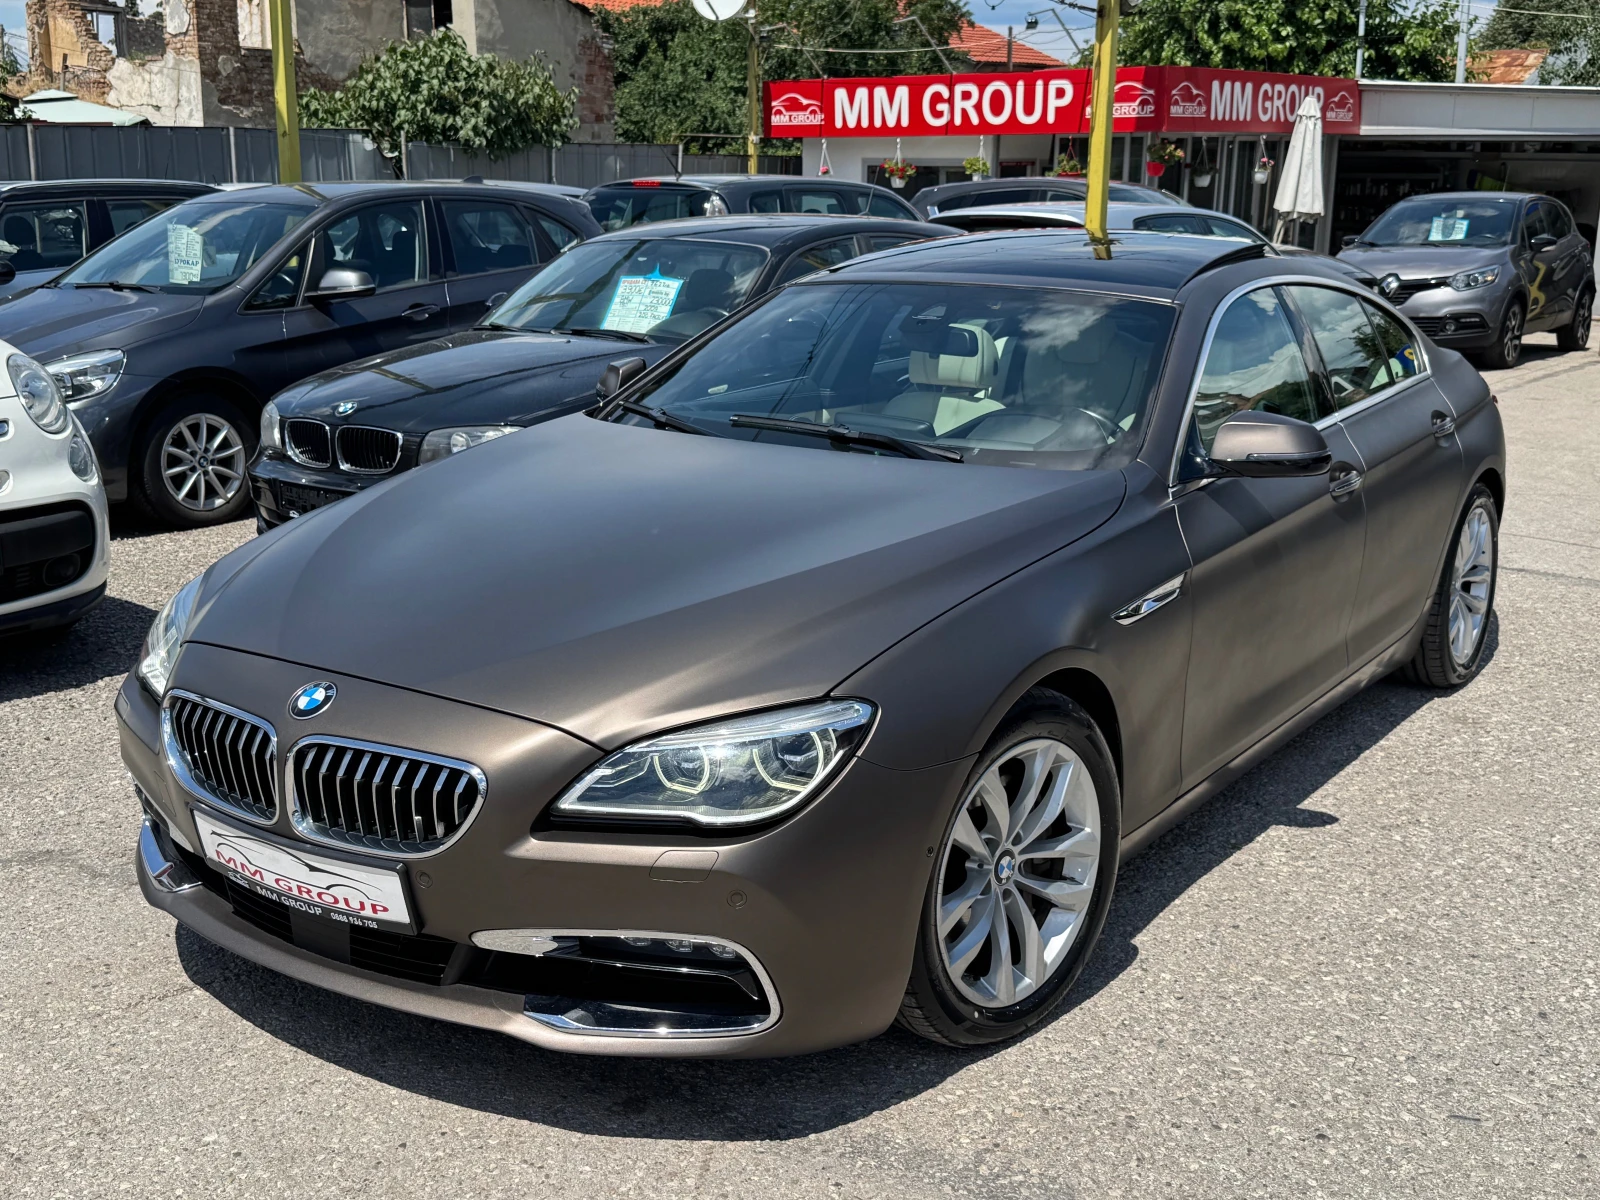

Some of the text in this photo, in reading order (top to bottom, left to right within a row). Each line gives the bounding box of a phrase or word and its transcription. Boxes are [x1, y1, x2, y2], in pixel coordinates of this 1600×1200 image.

[833, 78, 1074, 130] MM GROUP
[1112, 105, 1156, 115] GROUP
[1170, 105, 1207, 115] MM GROUP
[1209, 79, 1253, 122] MM
[771, 113, 825, 124] MM GROUP
[215, 849, 265, 881] MM
[274, 877, 390, 915] GROUP
[256, 885, 280, 902] MM
[281, 896, 323, 916] GROUP
